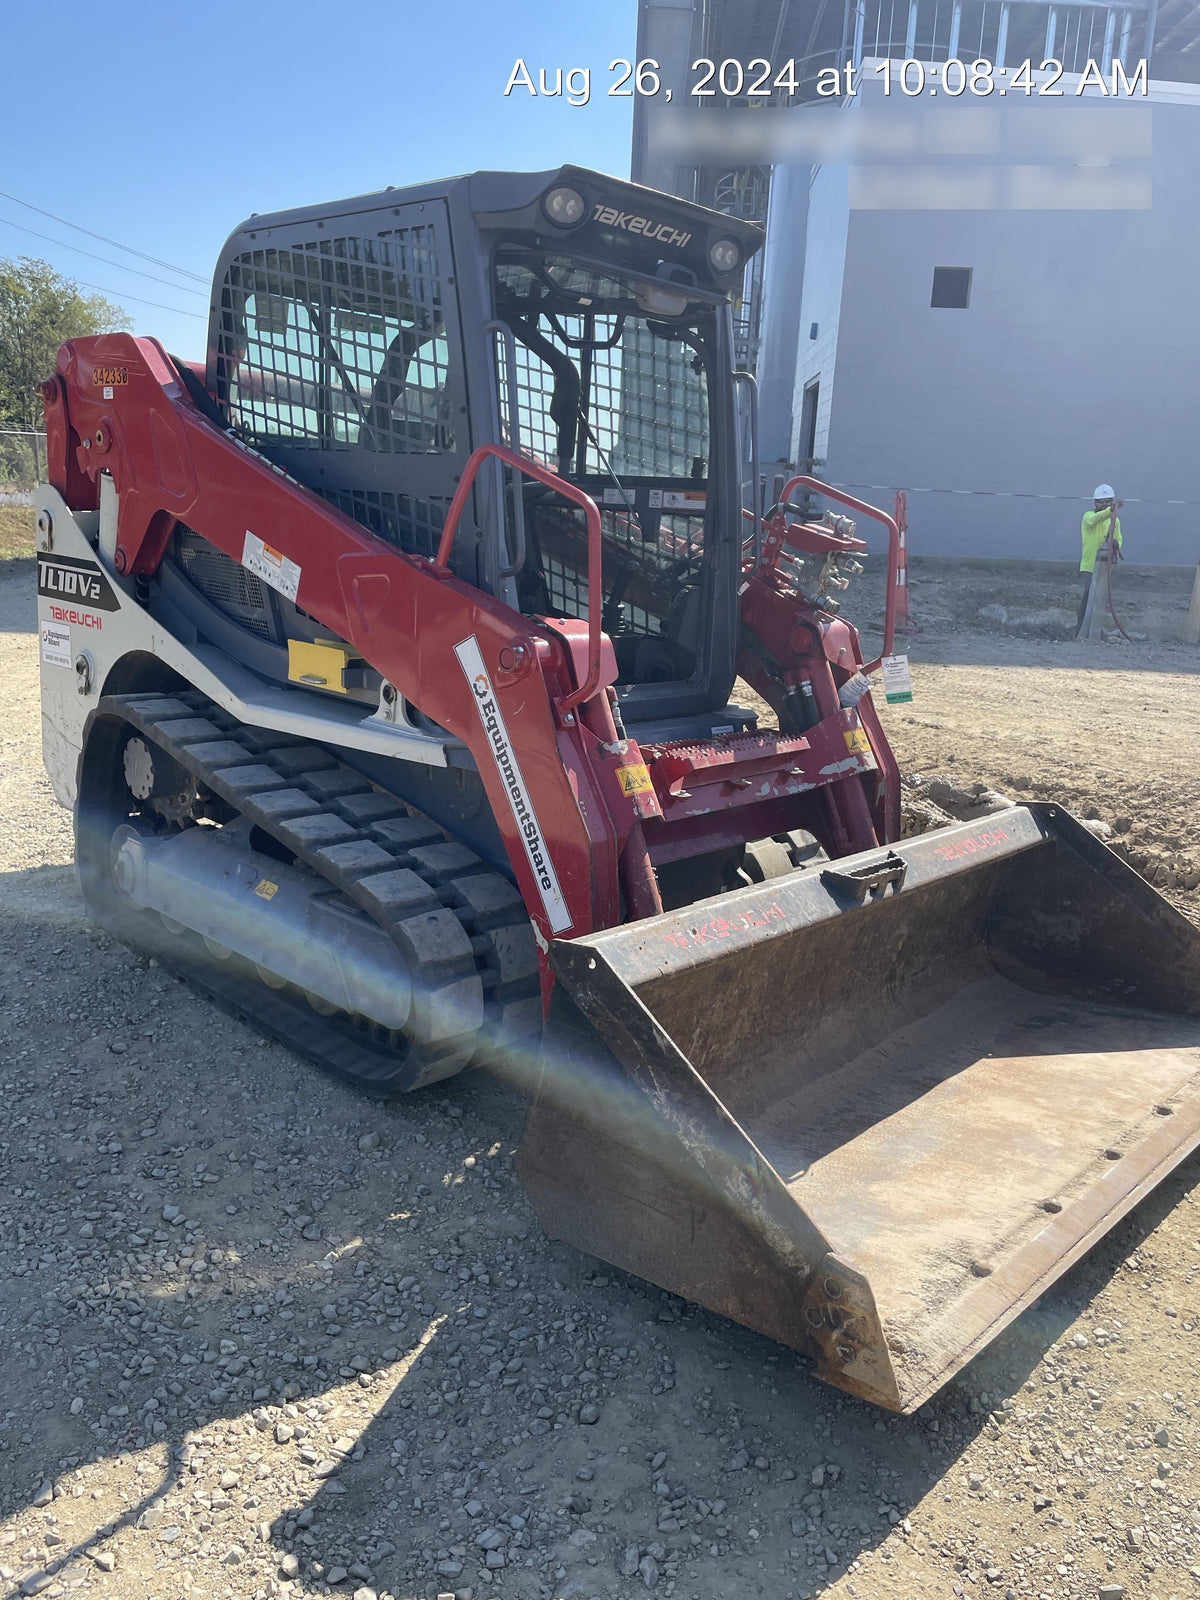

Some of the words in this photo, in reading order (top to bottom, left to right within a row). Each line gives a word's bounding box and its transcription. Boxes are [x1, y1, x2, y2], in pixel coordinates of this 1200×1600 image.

[593, 204, 692, 248] TAKEUCHI
[49, 606, 102, 630] TAKEUCHI
[482, 699, 552, 891] EquipmentShare
